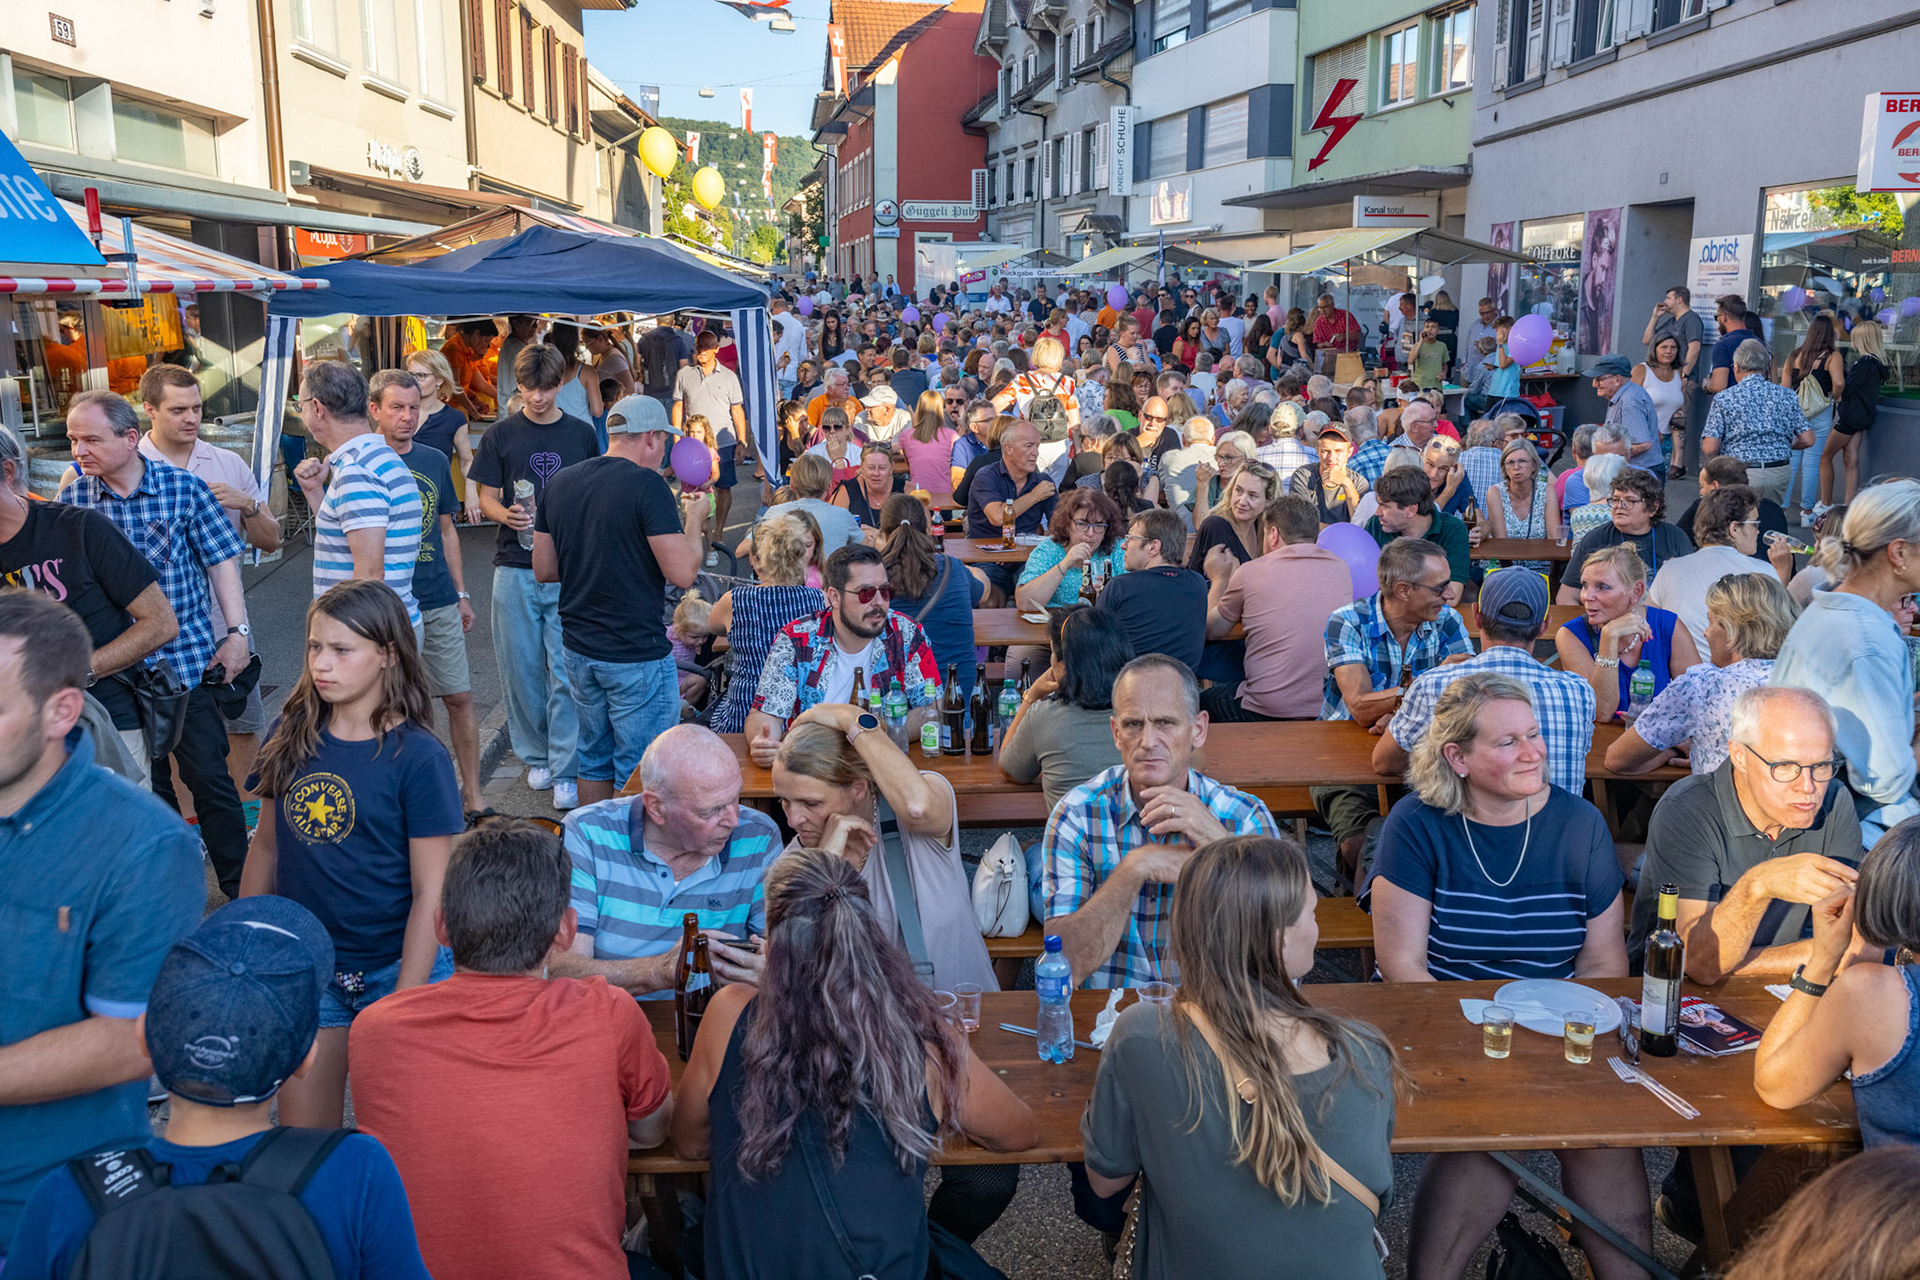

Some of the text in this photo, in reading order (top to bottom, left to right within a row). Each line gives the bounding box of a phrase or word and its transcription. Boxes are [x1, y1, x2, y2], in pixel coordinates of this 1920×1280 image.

[57, 21, 70, 38] 59
[1117, 108, 1126, 154] SCHUHE
[1897, 148, 1920, 157] BER
[905, 205, 975, 218] Güggeli Pub
[1364, 206, 1405, 214] Kanal total
[1000, 269, 1034, 277] Rückgabe
[294, 781, 348, 814] CONVERSE
[293, 815, 342, 838] ALL STAR
